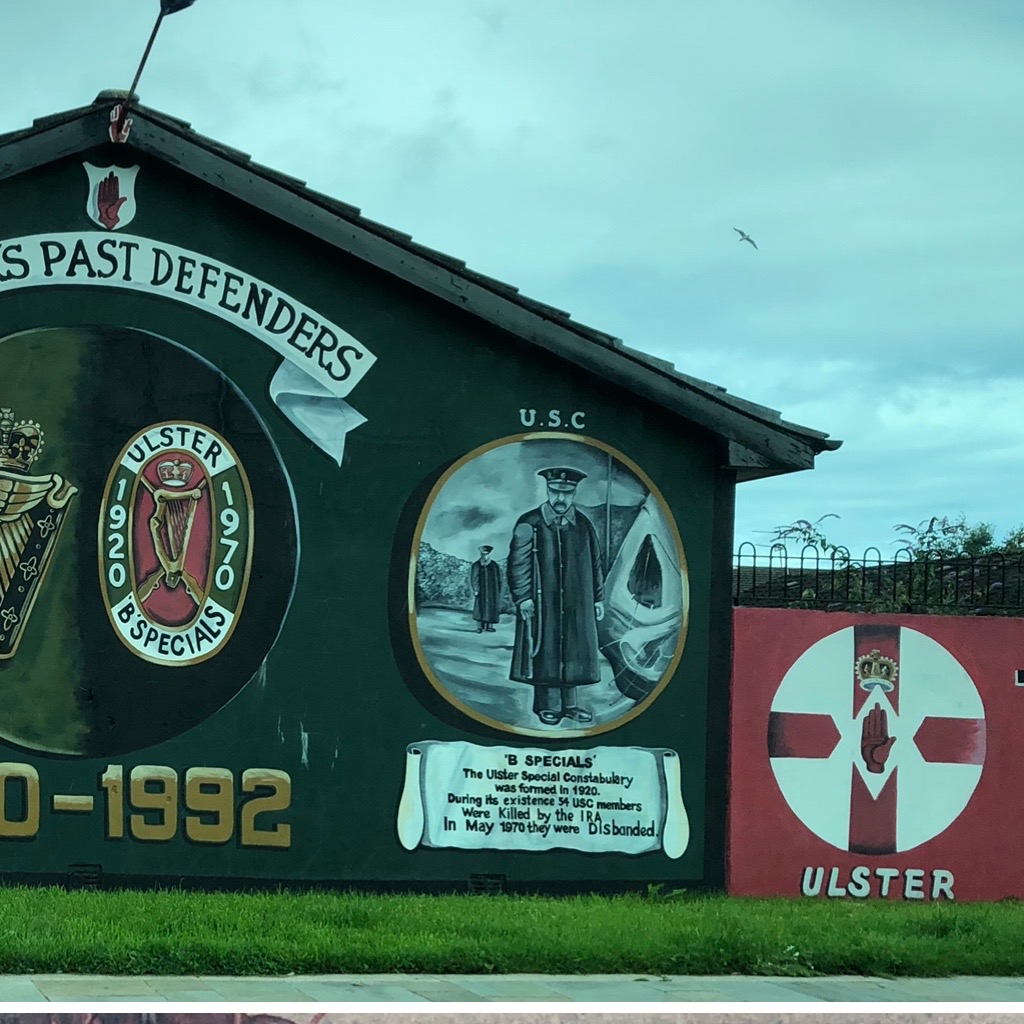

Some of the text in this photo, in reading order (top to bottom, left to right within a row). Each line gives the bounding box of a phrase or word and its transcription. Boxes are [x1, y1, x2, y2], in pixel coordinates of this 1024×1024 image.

[39, 239, 139, 282] PAST
[151, 247, 364, 382] DEFENDERS
[127, 426, 223, 469] ULSTER
[107, 478, 128, 588] 1920
[214, 481, 240, 591] 1970
[130, 605, 226, 657] SPECIALS
[462, 767, 634, 789] The Ulster Special Constabulary
[494, 783, 517, 793] was
[518, 783, 557, 795] formed
[572, 785, 601, 796] 1920.
[447, 792, 483, 808] During
[485, 793, 499, 806] its
[503, 794, 555, 806] existence
[572, 797, 594, 809] USC
[596, 797, 643, 812] members
[498, 806, 531, 820] Killed
[537, 808, 552, 824] by
[554, 808, 575, 822] the
[580, 810, 603, 823] IRA
[443, 816, 457, 832] In
[465, 818, 495, 836] May
[499, 821, 526, 833] 1970
[526, 820, 552, 839] they
[553, 823, 580, 834] were
[801, 865, 956, 900] ULSTER
